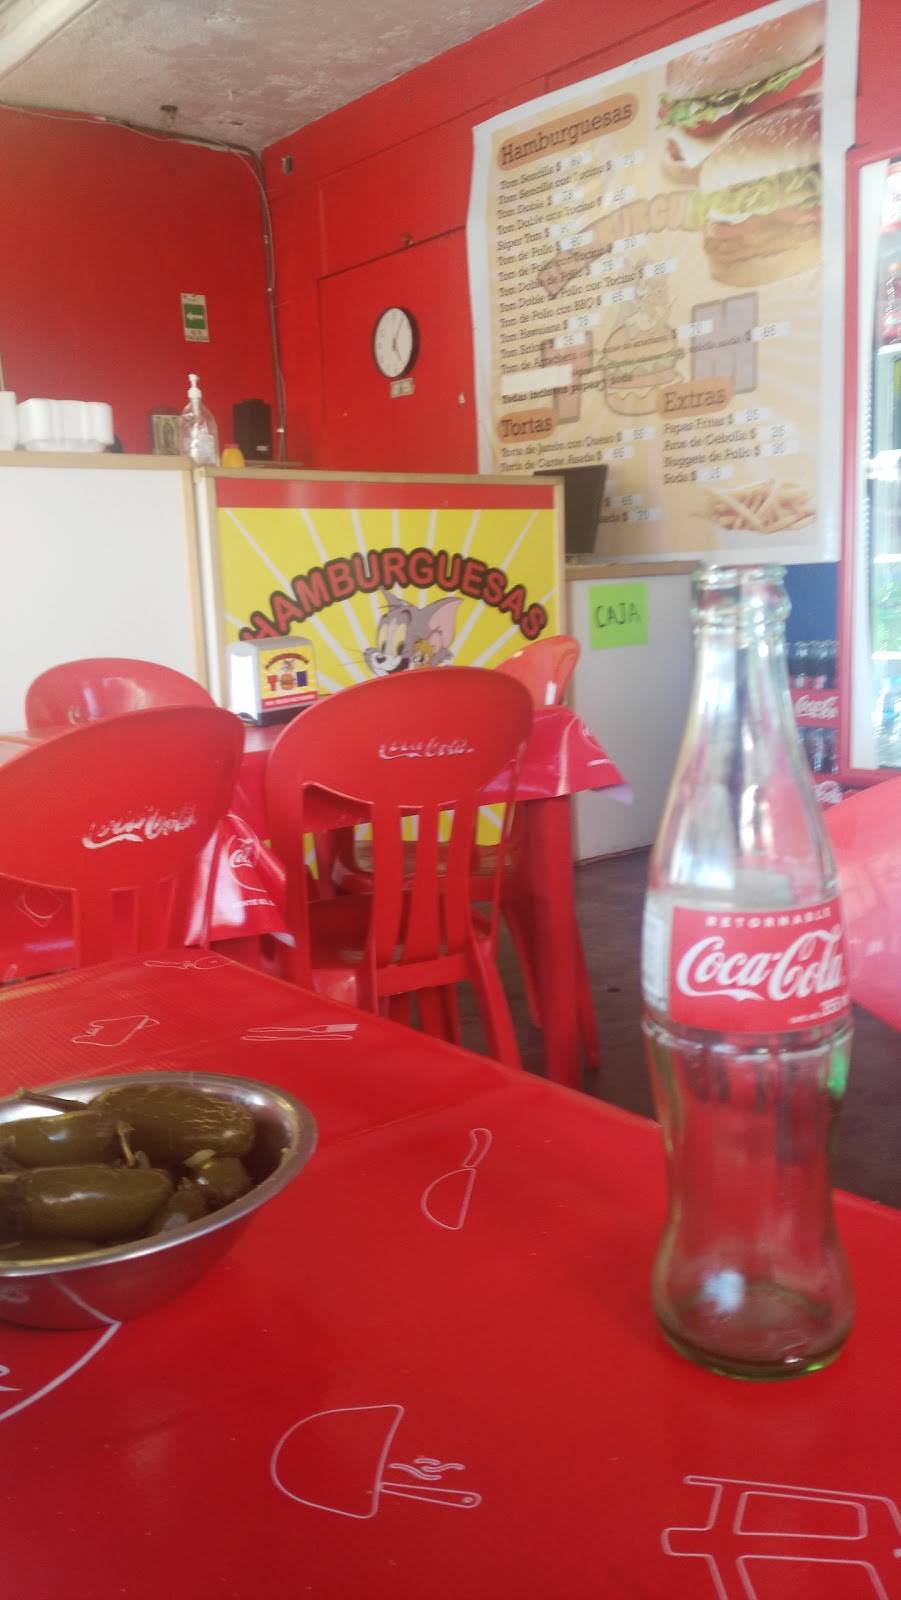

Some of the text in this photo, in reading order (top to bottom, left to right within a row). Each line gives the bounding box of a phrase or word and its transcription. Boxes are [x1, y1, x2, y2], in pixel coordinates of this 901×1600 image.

[501, 103, 633, 166] Hamburguesas
[664, 389, 727, 413] Extras
[501, 417, 553, 438] Tortas
[240, 547, 548, 640] HAMBURGUESAS
[594, 602, 642, 628] CAJA
[704, 906, 833, 929] RETORNABLE
[676, 923, 846, 1002] Coca-Cola
